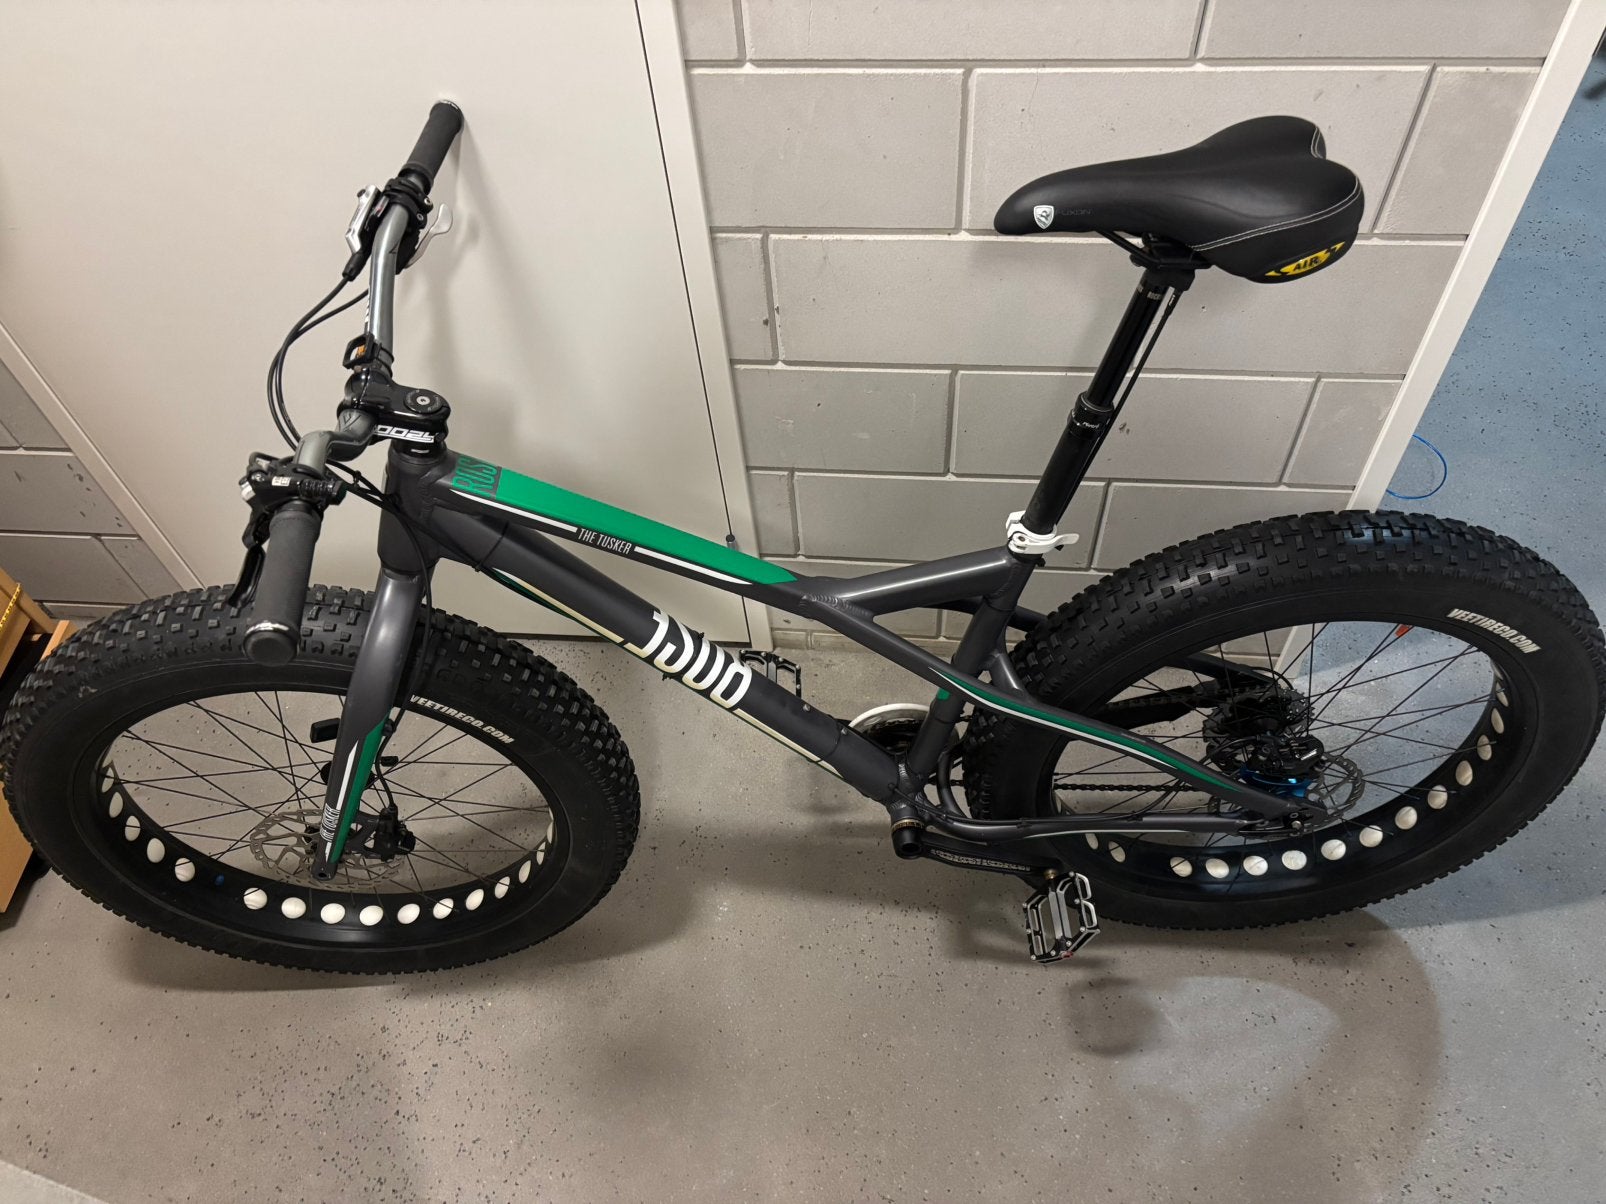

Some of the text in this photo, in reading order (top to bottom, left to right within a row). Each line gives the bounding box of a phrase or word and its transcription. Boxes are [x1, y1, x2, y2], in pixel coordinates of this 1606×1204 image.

[1294, 256, 1319, 271] AIR
[578, 528, 632, 555] THE TUSKER
[1446, 608, 1541, 654] VEETIRECO.COM
[410, 695, 515, 744] VEETIRECO.COM
